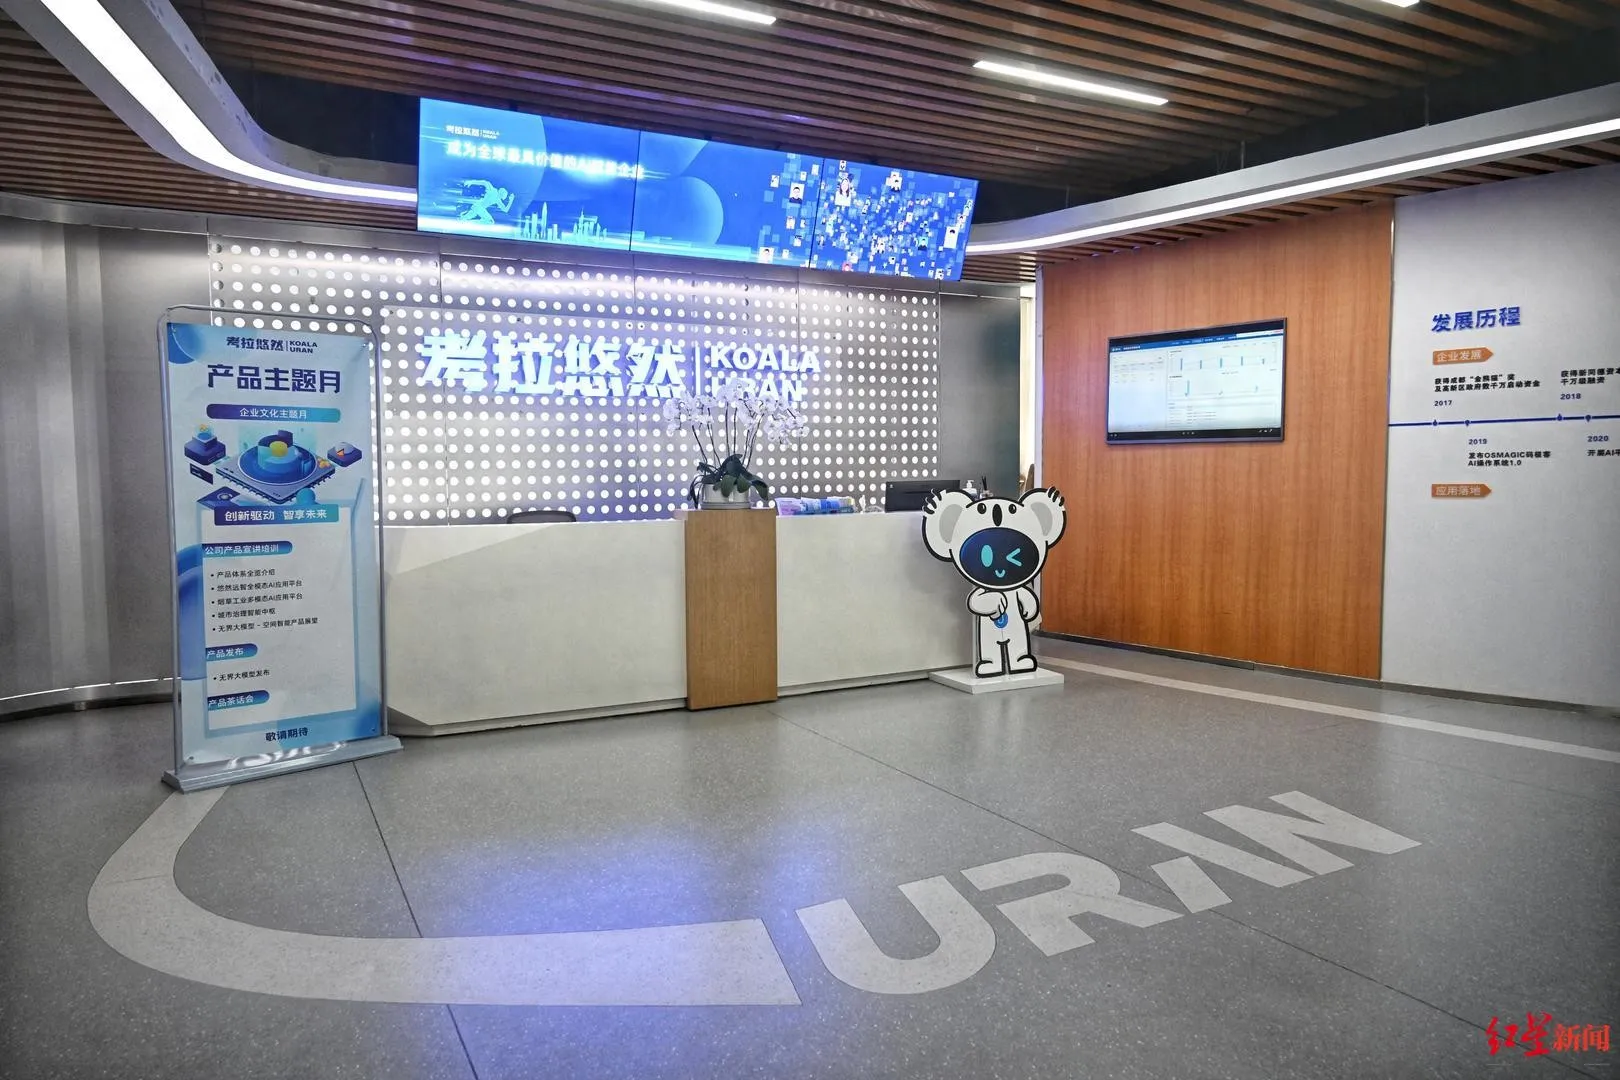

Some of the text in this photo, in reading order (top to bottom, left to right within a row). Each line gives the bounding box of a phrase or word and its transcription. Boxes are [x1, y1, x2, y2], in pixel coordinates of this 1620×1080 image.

[1431, 306, 1521, 332] 发展历程
[226, 336, 318, 351] 考拉悠然 KOALA
[1436, 349, 1483, 362] 企业发展
[420, 333, 821, 399] 考拉悠然 KOALA
[207, 363, 341, 394] 产品主题月
[239, 407, 307, 420] 企业文化主题月
[1587, 435, 1609, 443] 2020
[1467, 459, 1522, 467] AI操作系统1.0
[1436, 484, 1481, 496] 应用落地
[224, 509, 327, 522] 创新驱动 智享未来
[204, 544, 279, 555] 公司产品宣讲培训
[217, 593, 303, 606] 烟草工业多模态AI应用平台
[217, 607, 276, 619] 城市治理智能中枢
[218, 622, 255, 633] 无界大模型
[206, 647, 244, 660] 产品发布
[219, 669, 271, 682] 无界大模型发布
[208, 694, 254, 708] 产品茶话会
[265, 727, 309, 742] 敬请期待
[794, 790, 1423, 994] URAN
